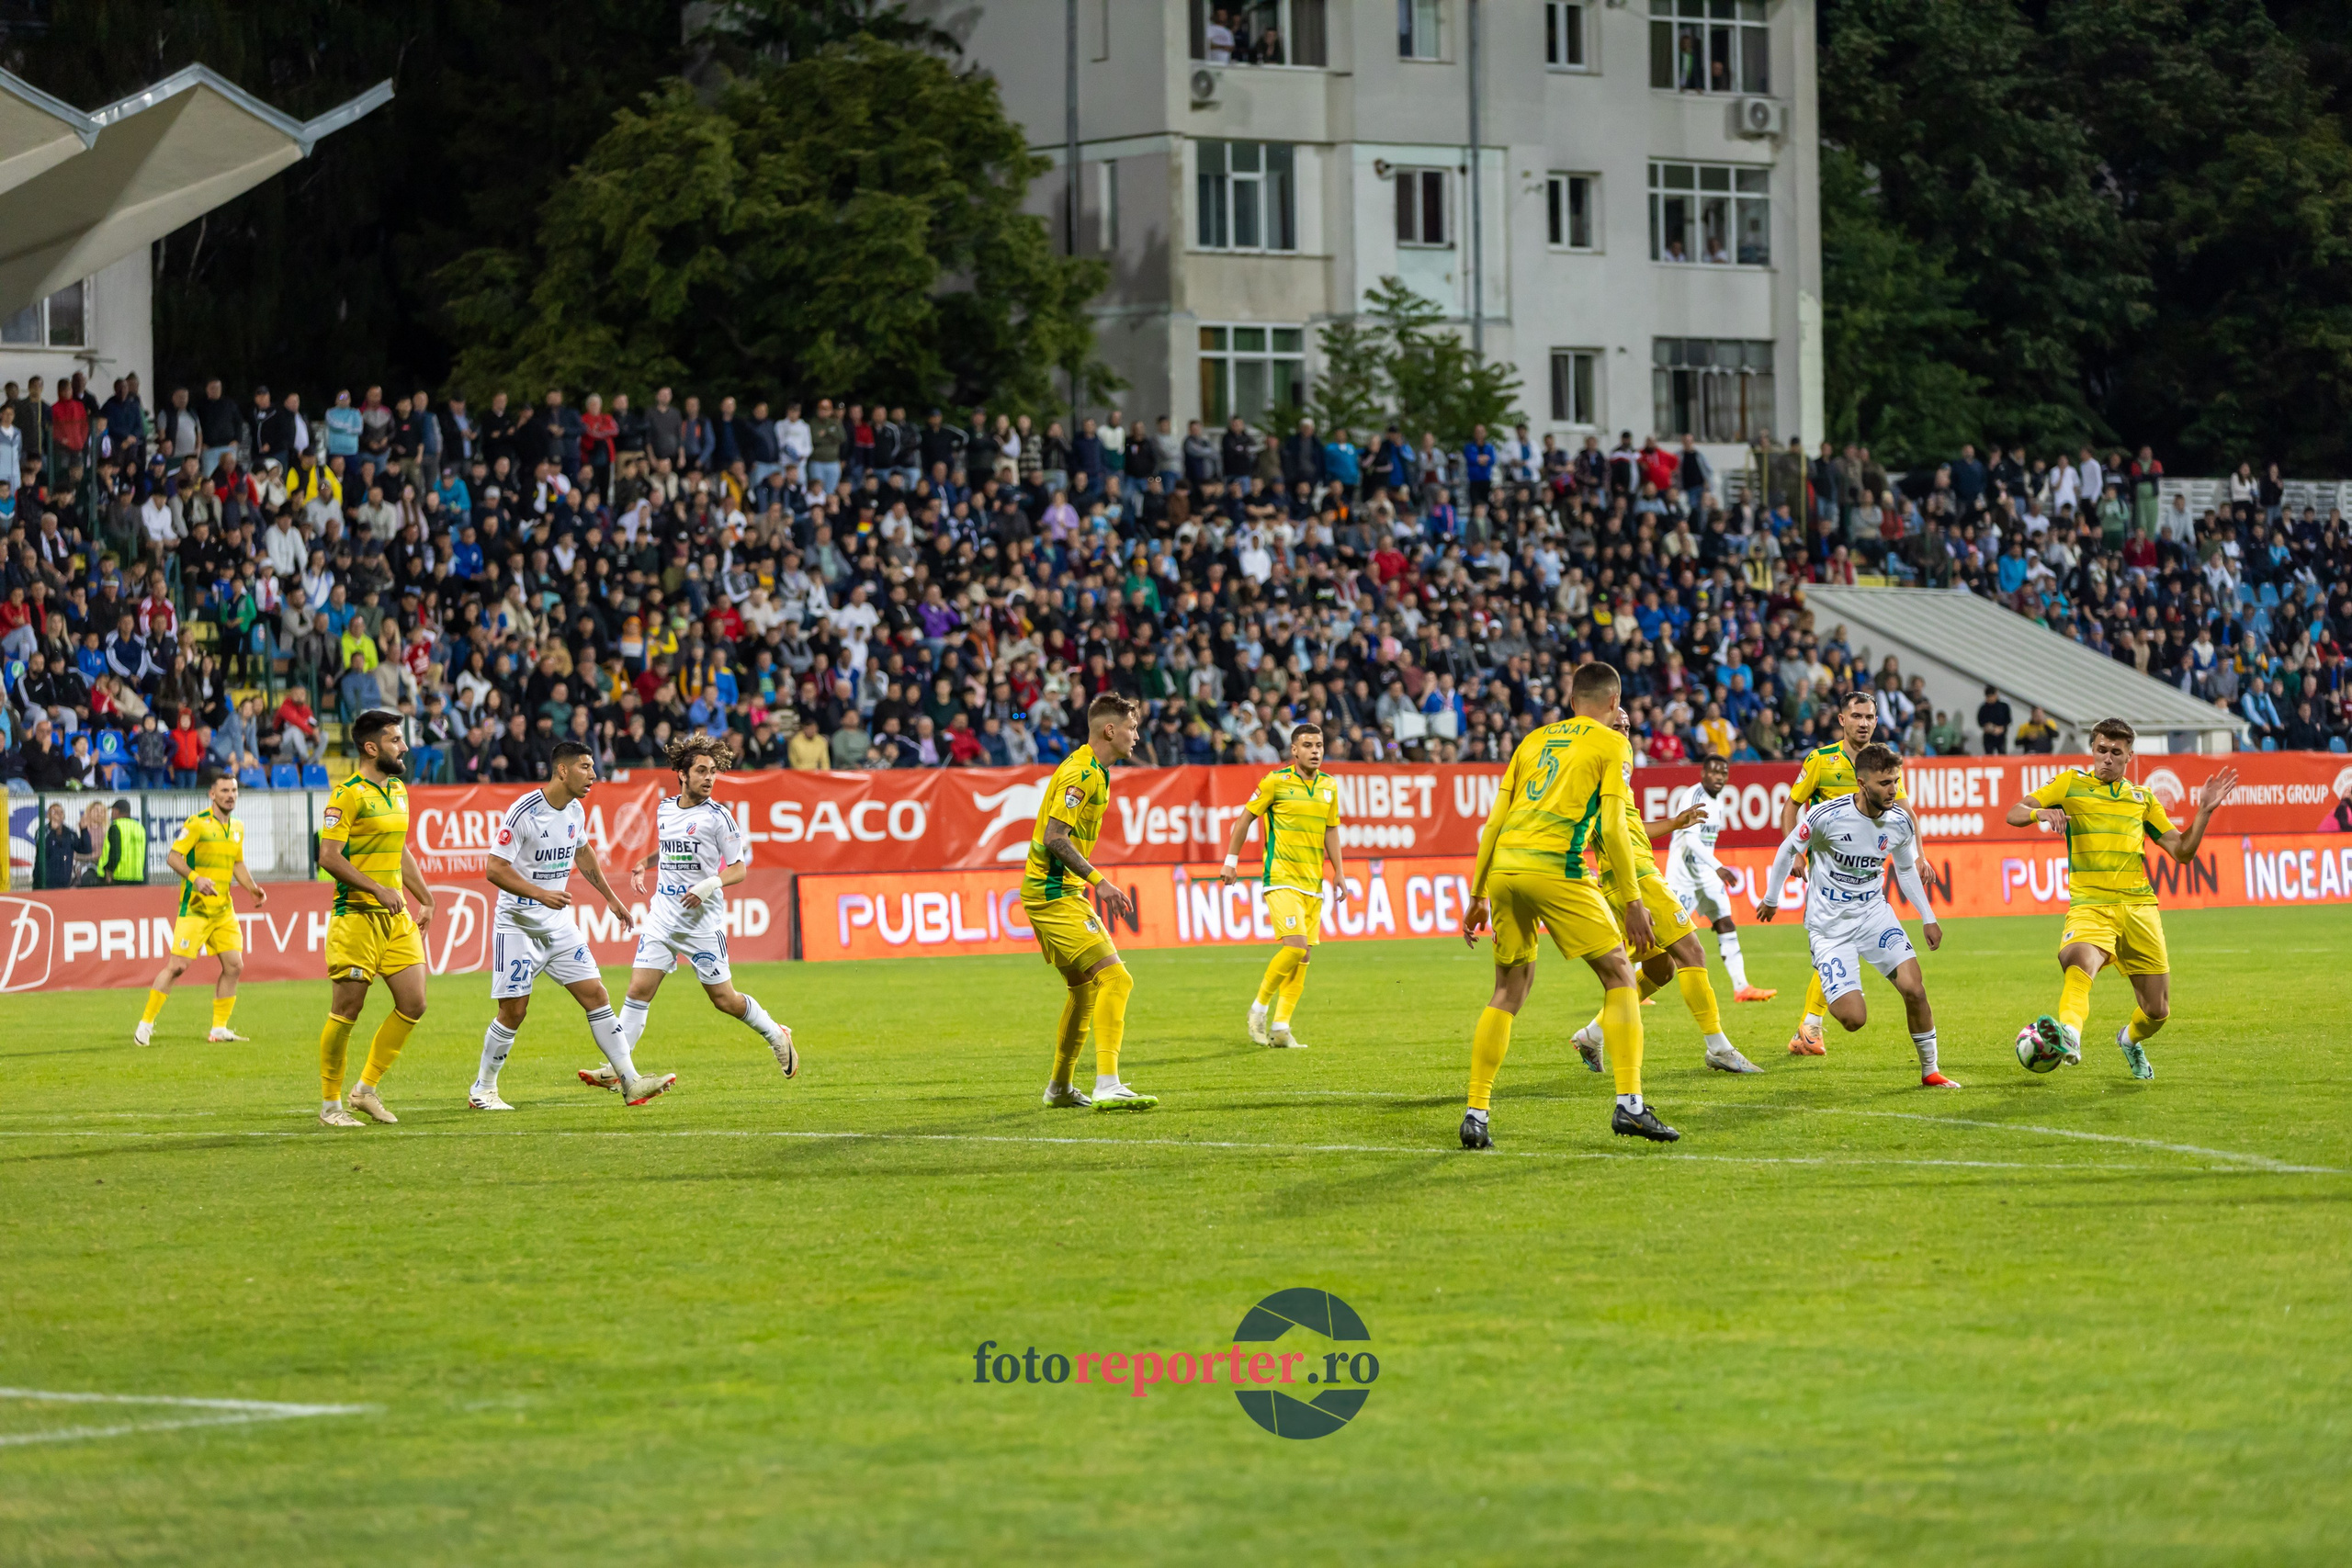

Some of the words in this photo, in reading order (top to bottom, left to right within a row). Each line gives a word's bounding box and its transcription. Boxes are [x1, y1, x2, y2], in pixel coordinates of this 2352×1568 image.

[1543, 723, 1595, 736] IGNAT
[1526, 739, 1573, 801] 5
[1337, 774, 1437, 818] NIBET
[2287, 784, 2329, 804] GROUP
[732, 799, 927, 843] LSACO
[1174, 862, 1396, 942] ÎNCERCĂ
[235, 911, 300, 953] TV
[511, 959, 531, 981] 27
[1822, 957, 1847, 984] 93
